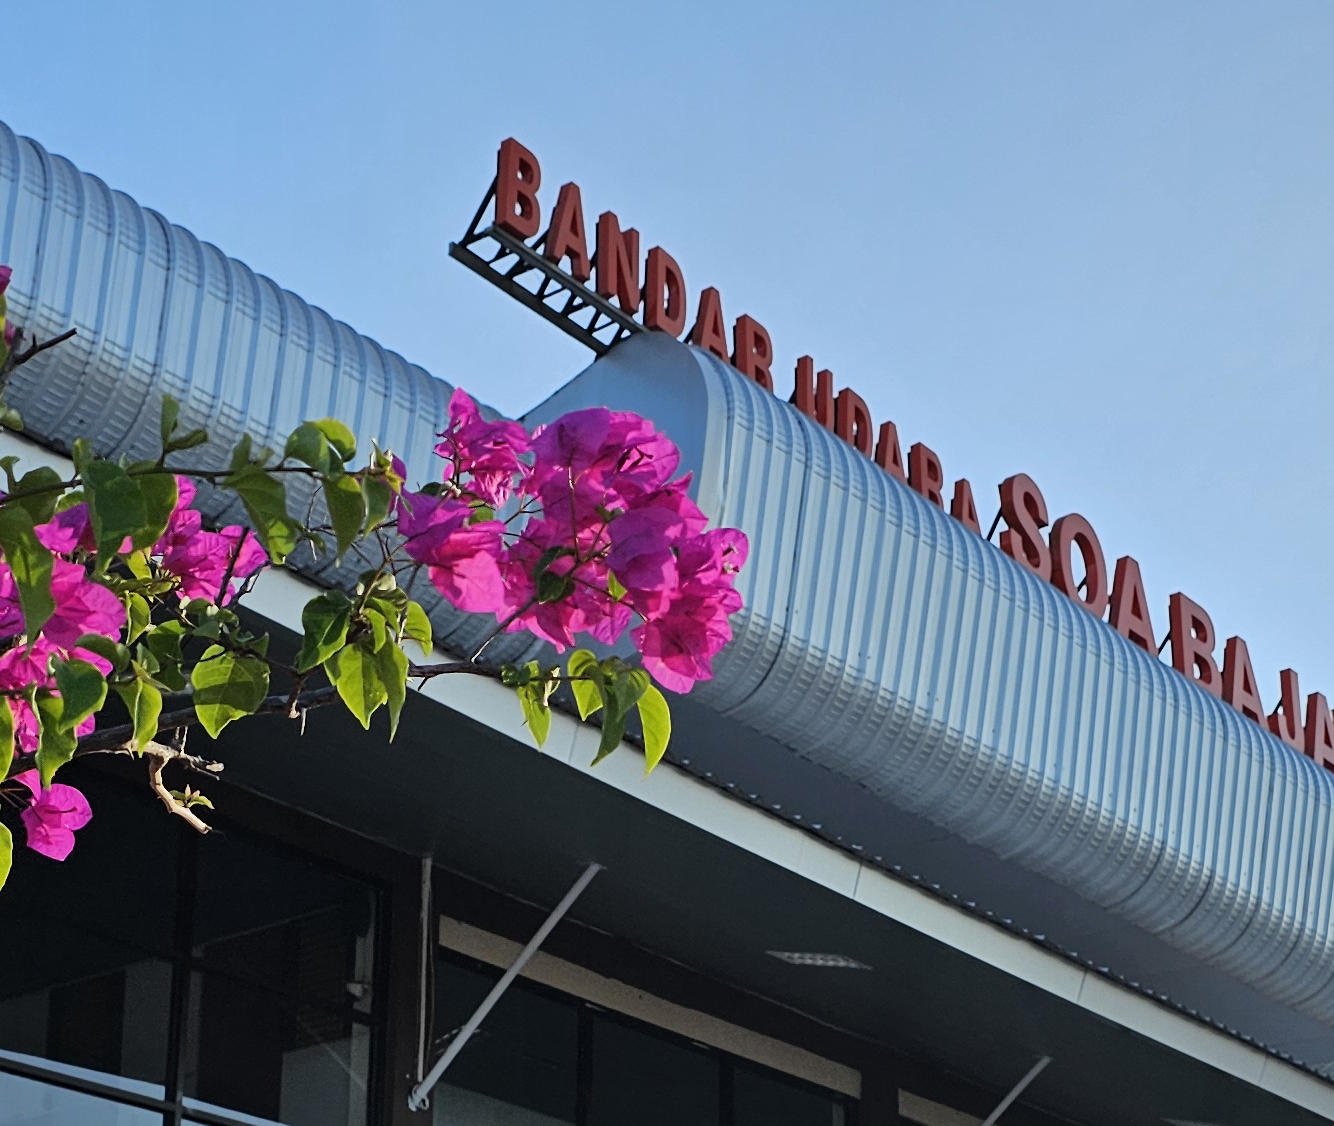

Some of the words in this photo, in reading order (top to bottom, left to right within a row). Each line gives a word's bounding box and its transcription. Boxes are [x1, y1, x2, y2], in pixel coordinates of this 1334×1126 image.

[494, 137, 773, 394] BANDAR
[794, 355, 982, 537] UDARA
[998, 473, 1159, 657] SOA
